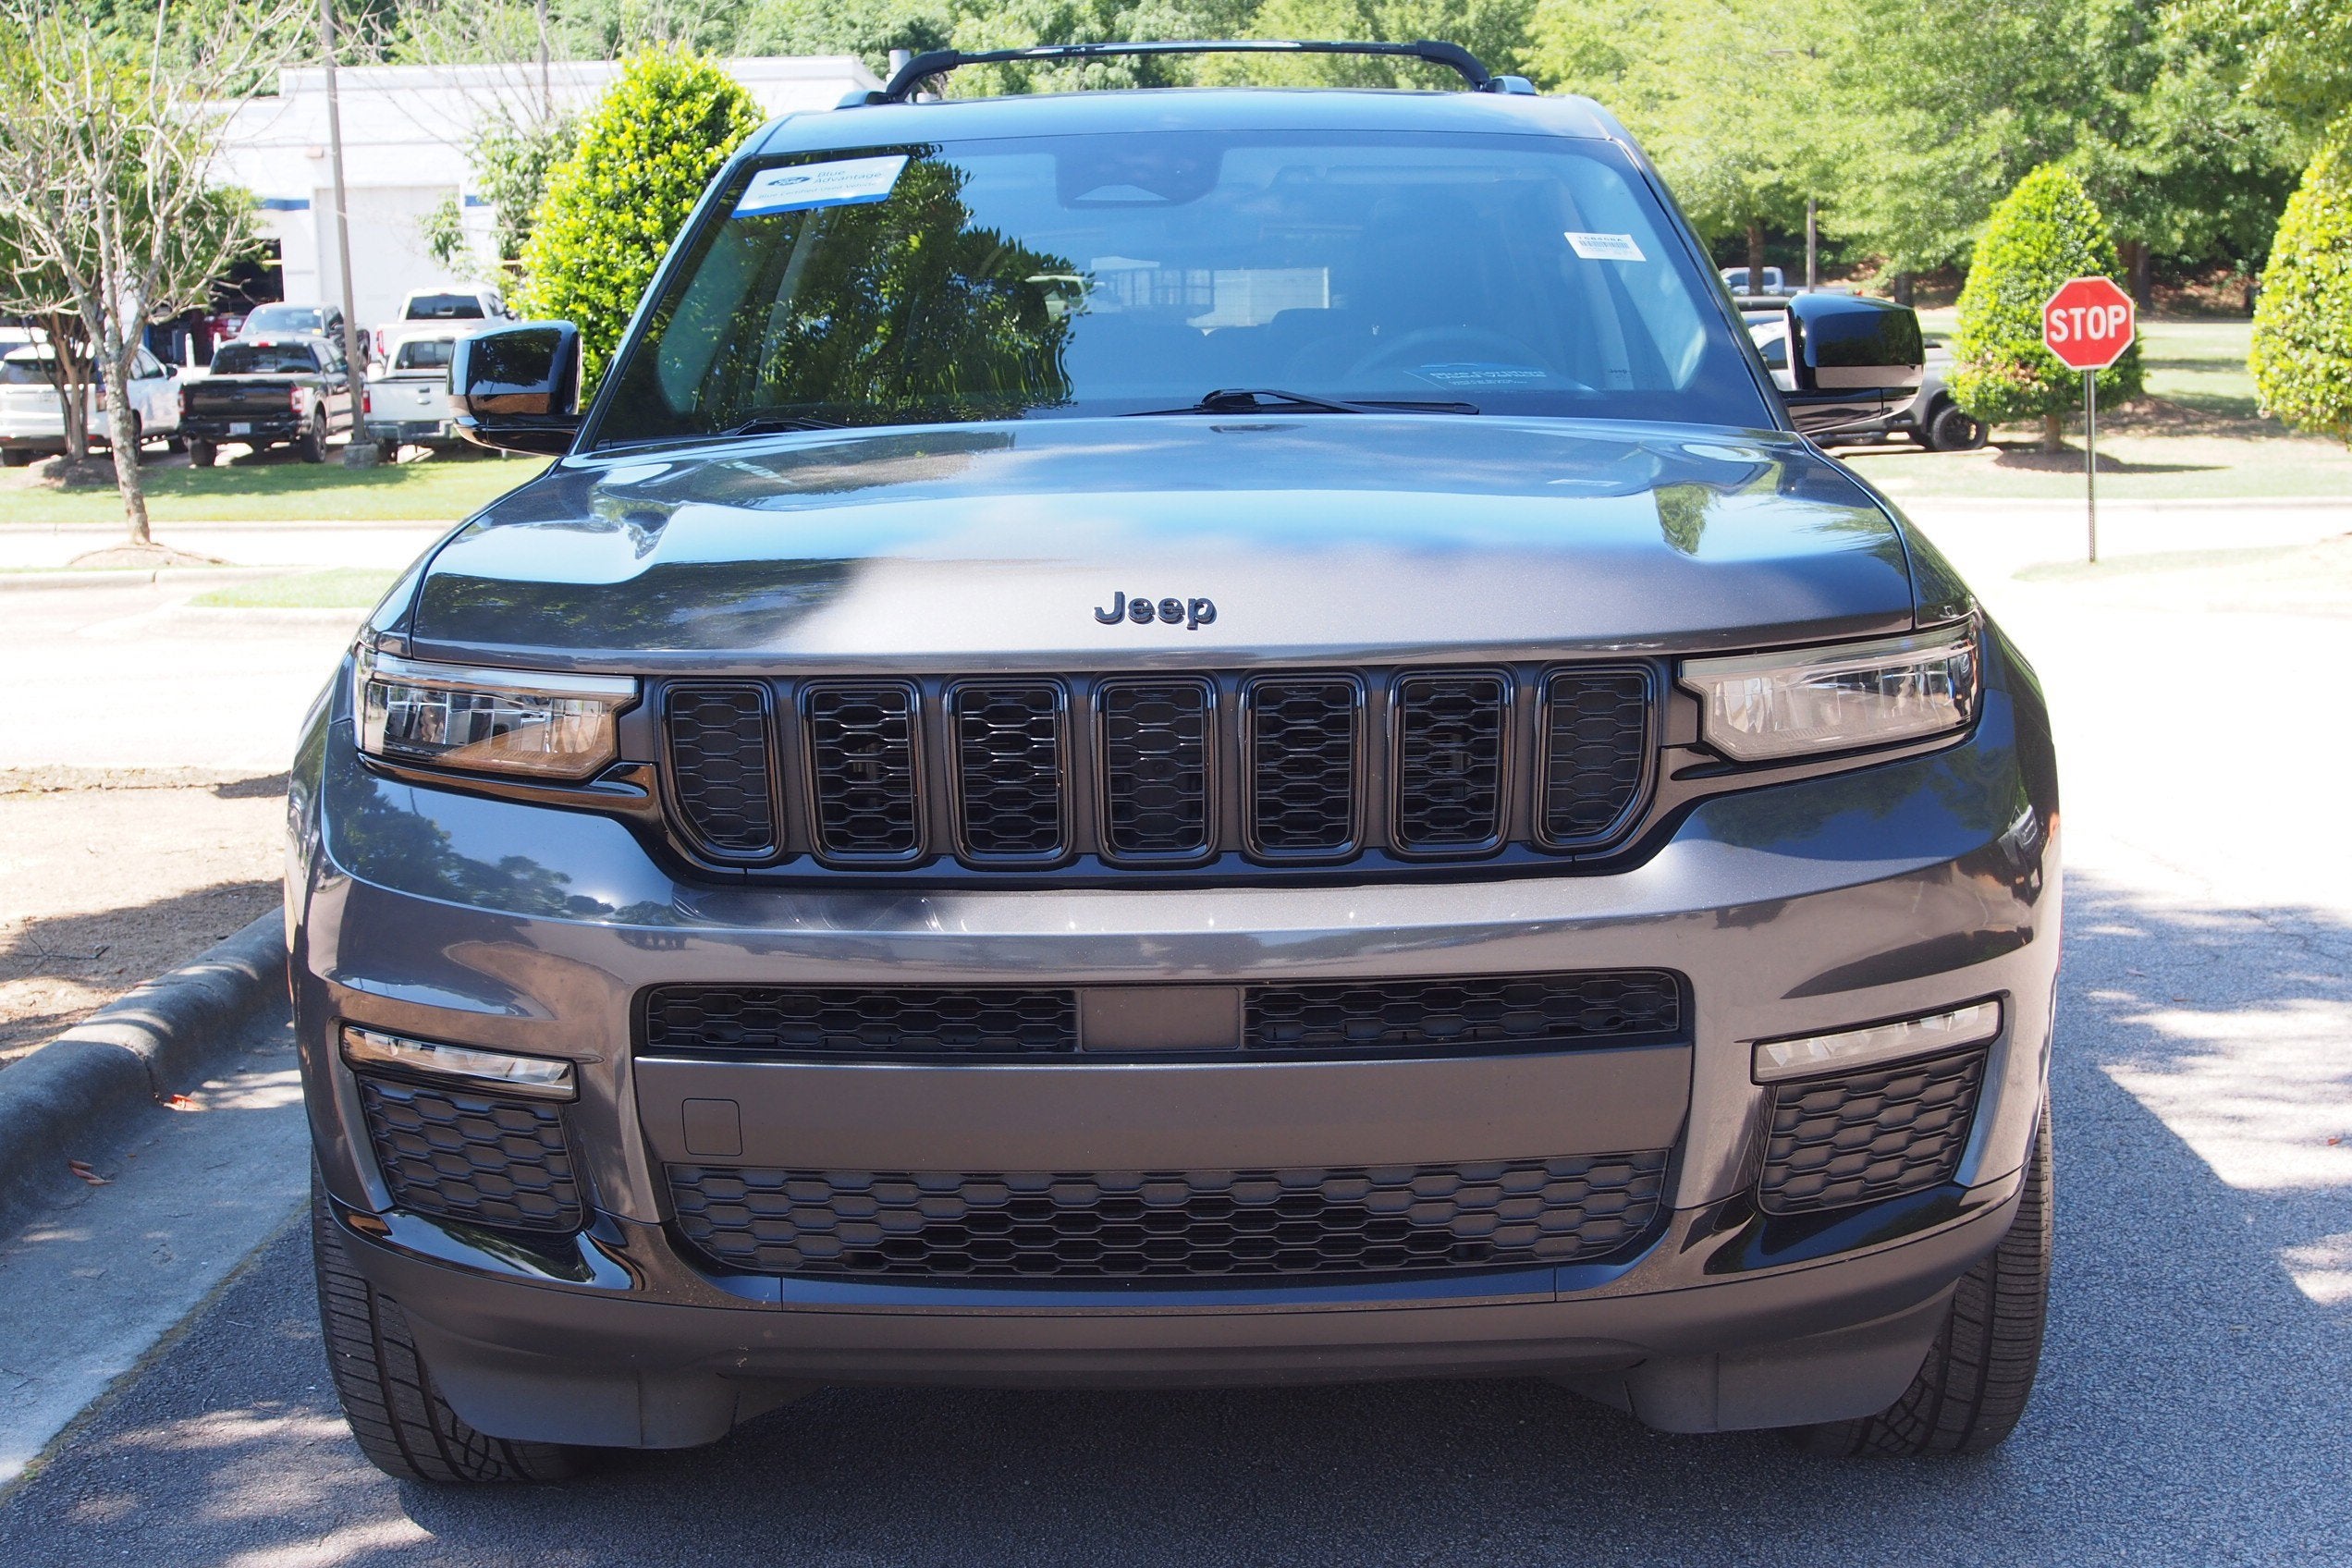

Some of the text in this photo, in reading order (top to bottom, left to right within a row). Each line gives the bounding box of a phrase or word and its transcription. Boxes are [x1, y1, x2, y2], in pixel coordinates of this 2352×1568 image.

[814, 172, 883, 184] Advantage
[2050, 305, 2126, 342] STOP
[1094, 592, 1217, 631] Jeep
